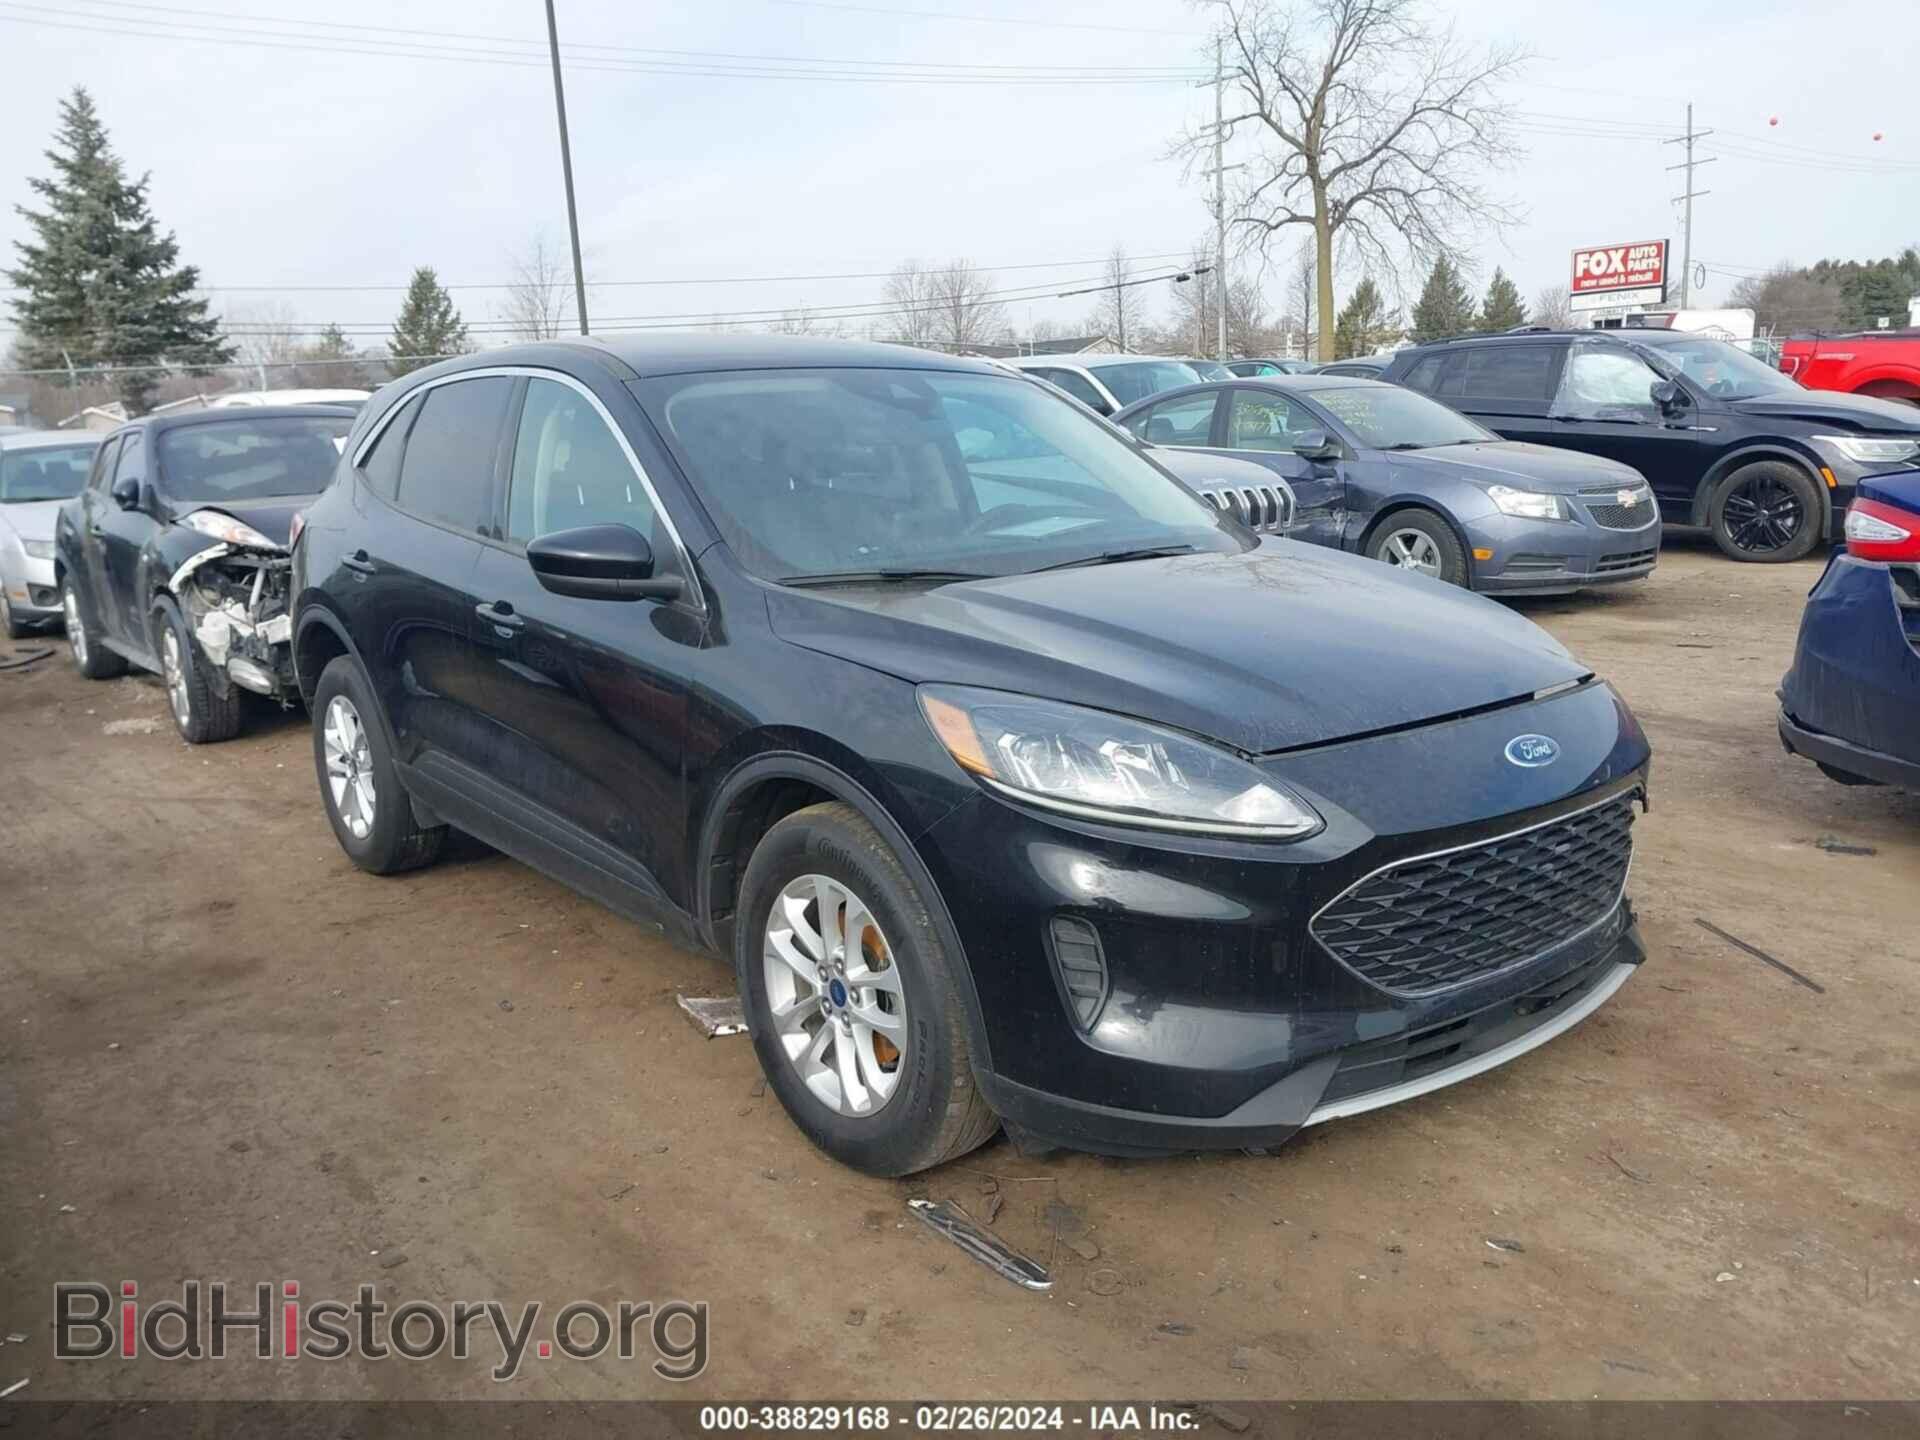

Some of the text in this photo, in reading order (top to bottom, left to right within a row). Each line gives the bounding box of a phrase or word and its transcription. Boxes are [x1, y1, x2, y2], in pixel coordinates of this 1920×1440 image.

[1629, 246, 1658, 259] AUTO
[1575, 249, 1626, 278] FOX
[1627, 258, 1660, 271] PARTS
